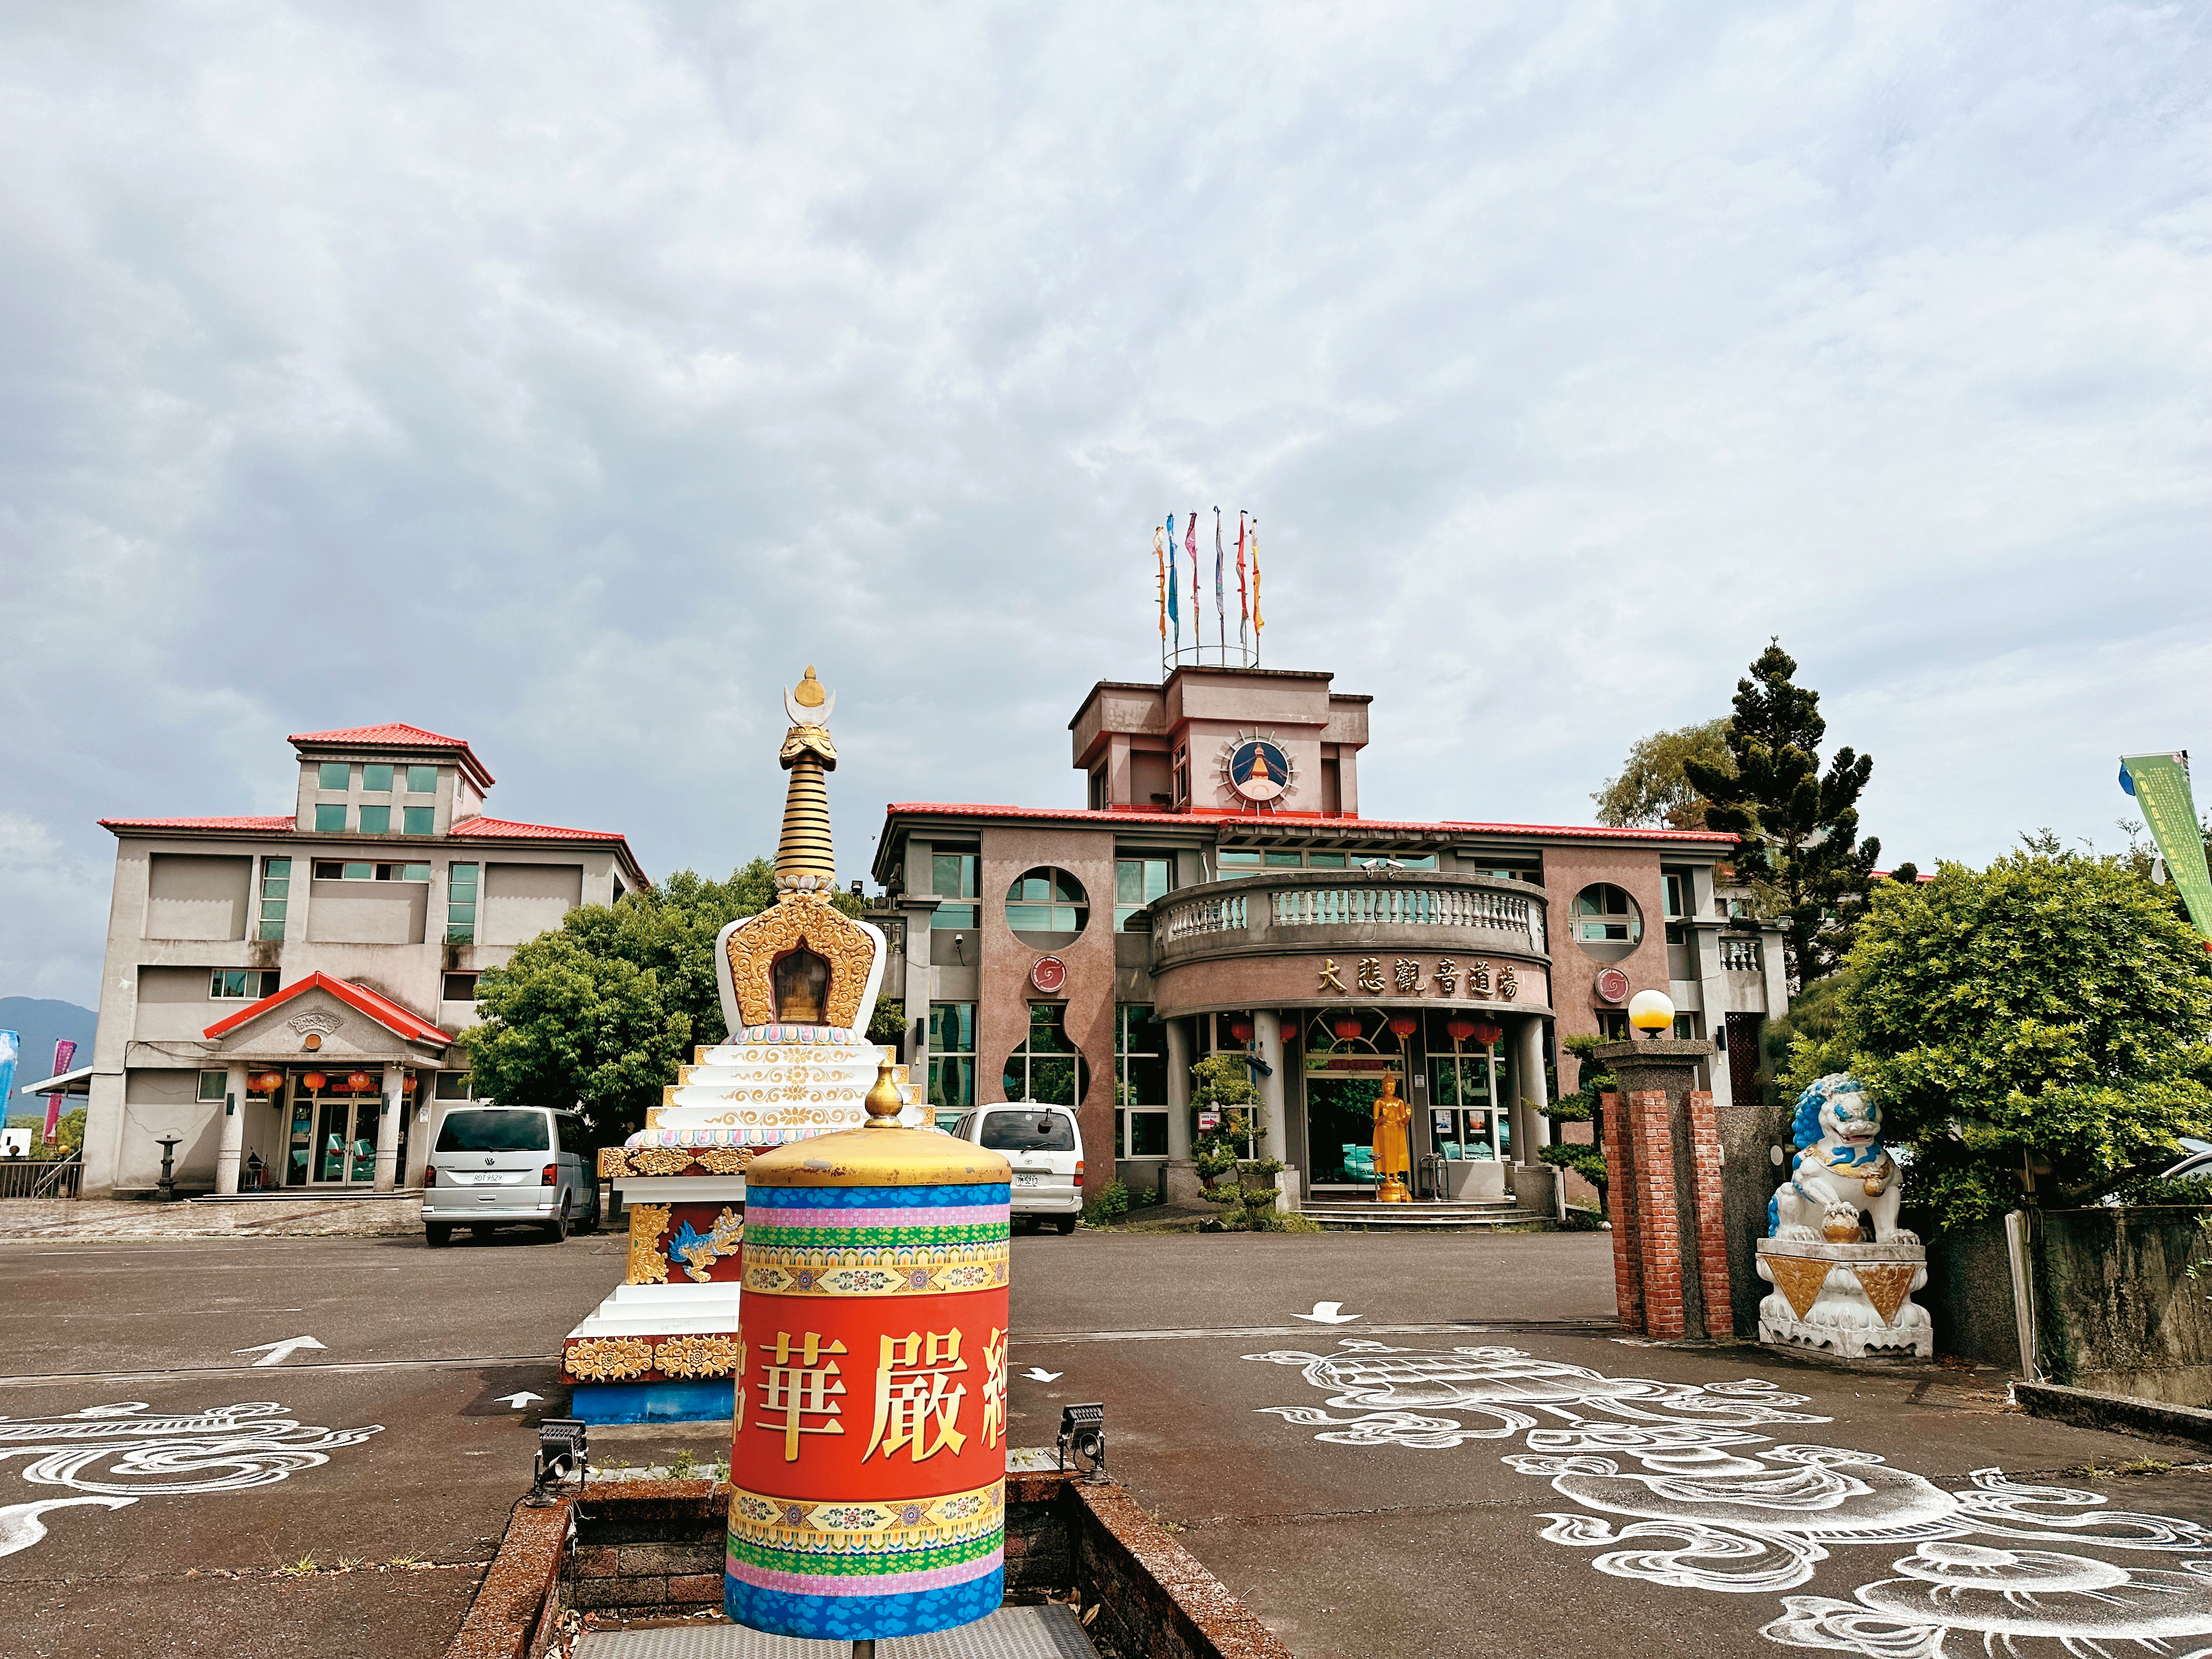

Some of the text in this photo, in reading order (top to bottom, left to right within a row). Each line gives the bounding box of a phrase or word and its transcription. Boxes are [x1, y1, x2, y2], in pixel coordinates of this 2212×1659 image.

[1317, 957, 1518, 998] 大悲觀音道場
